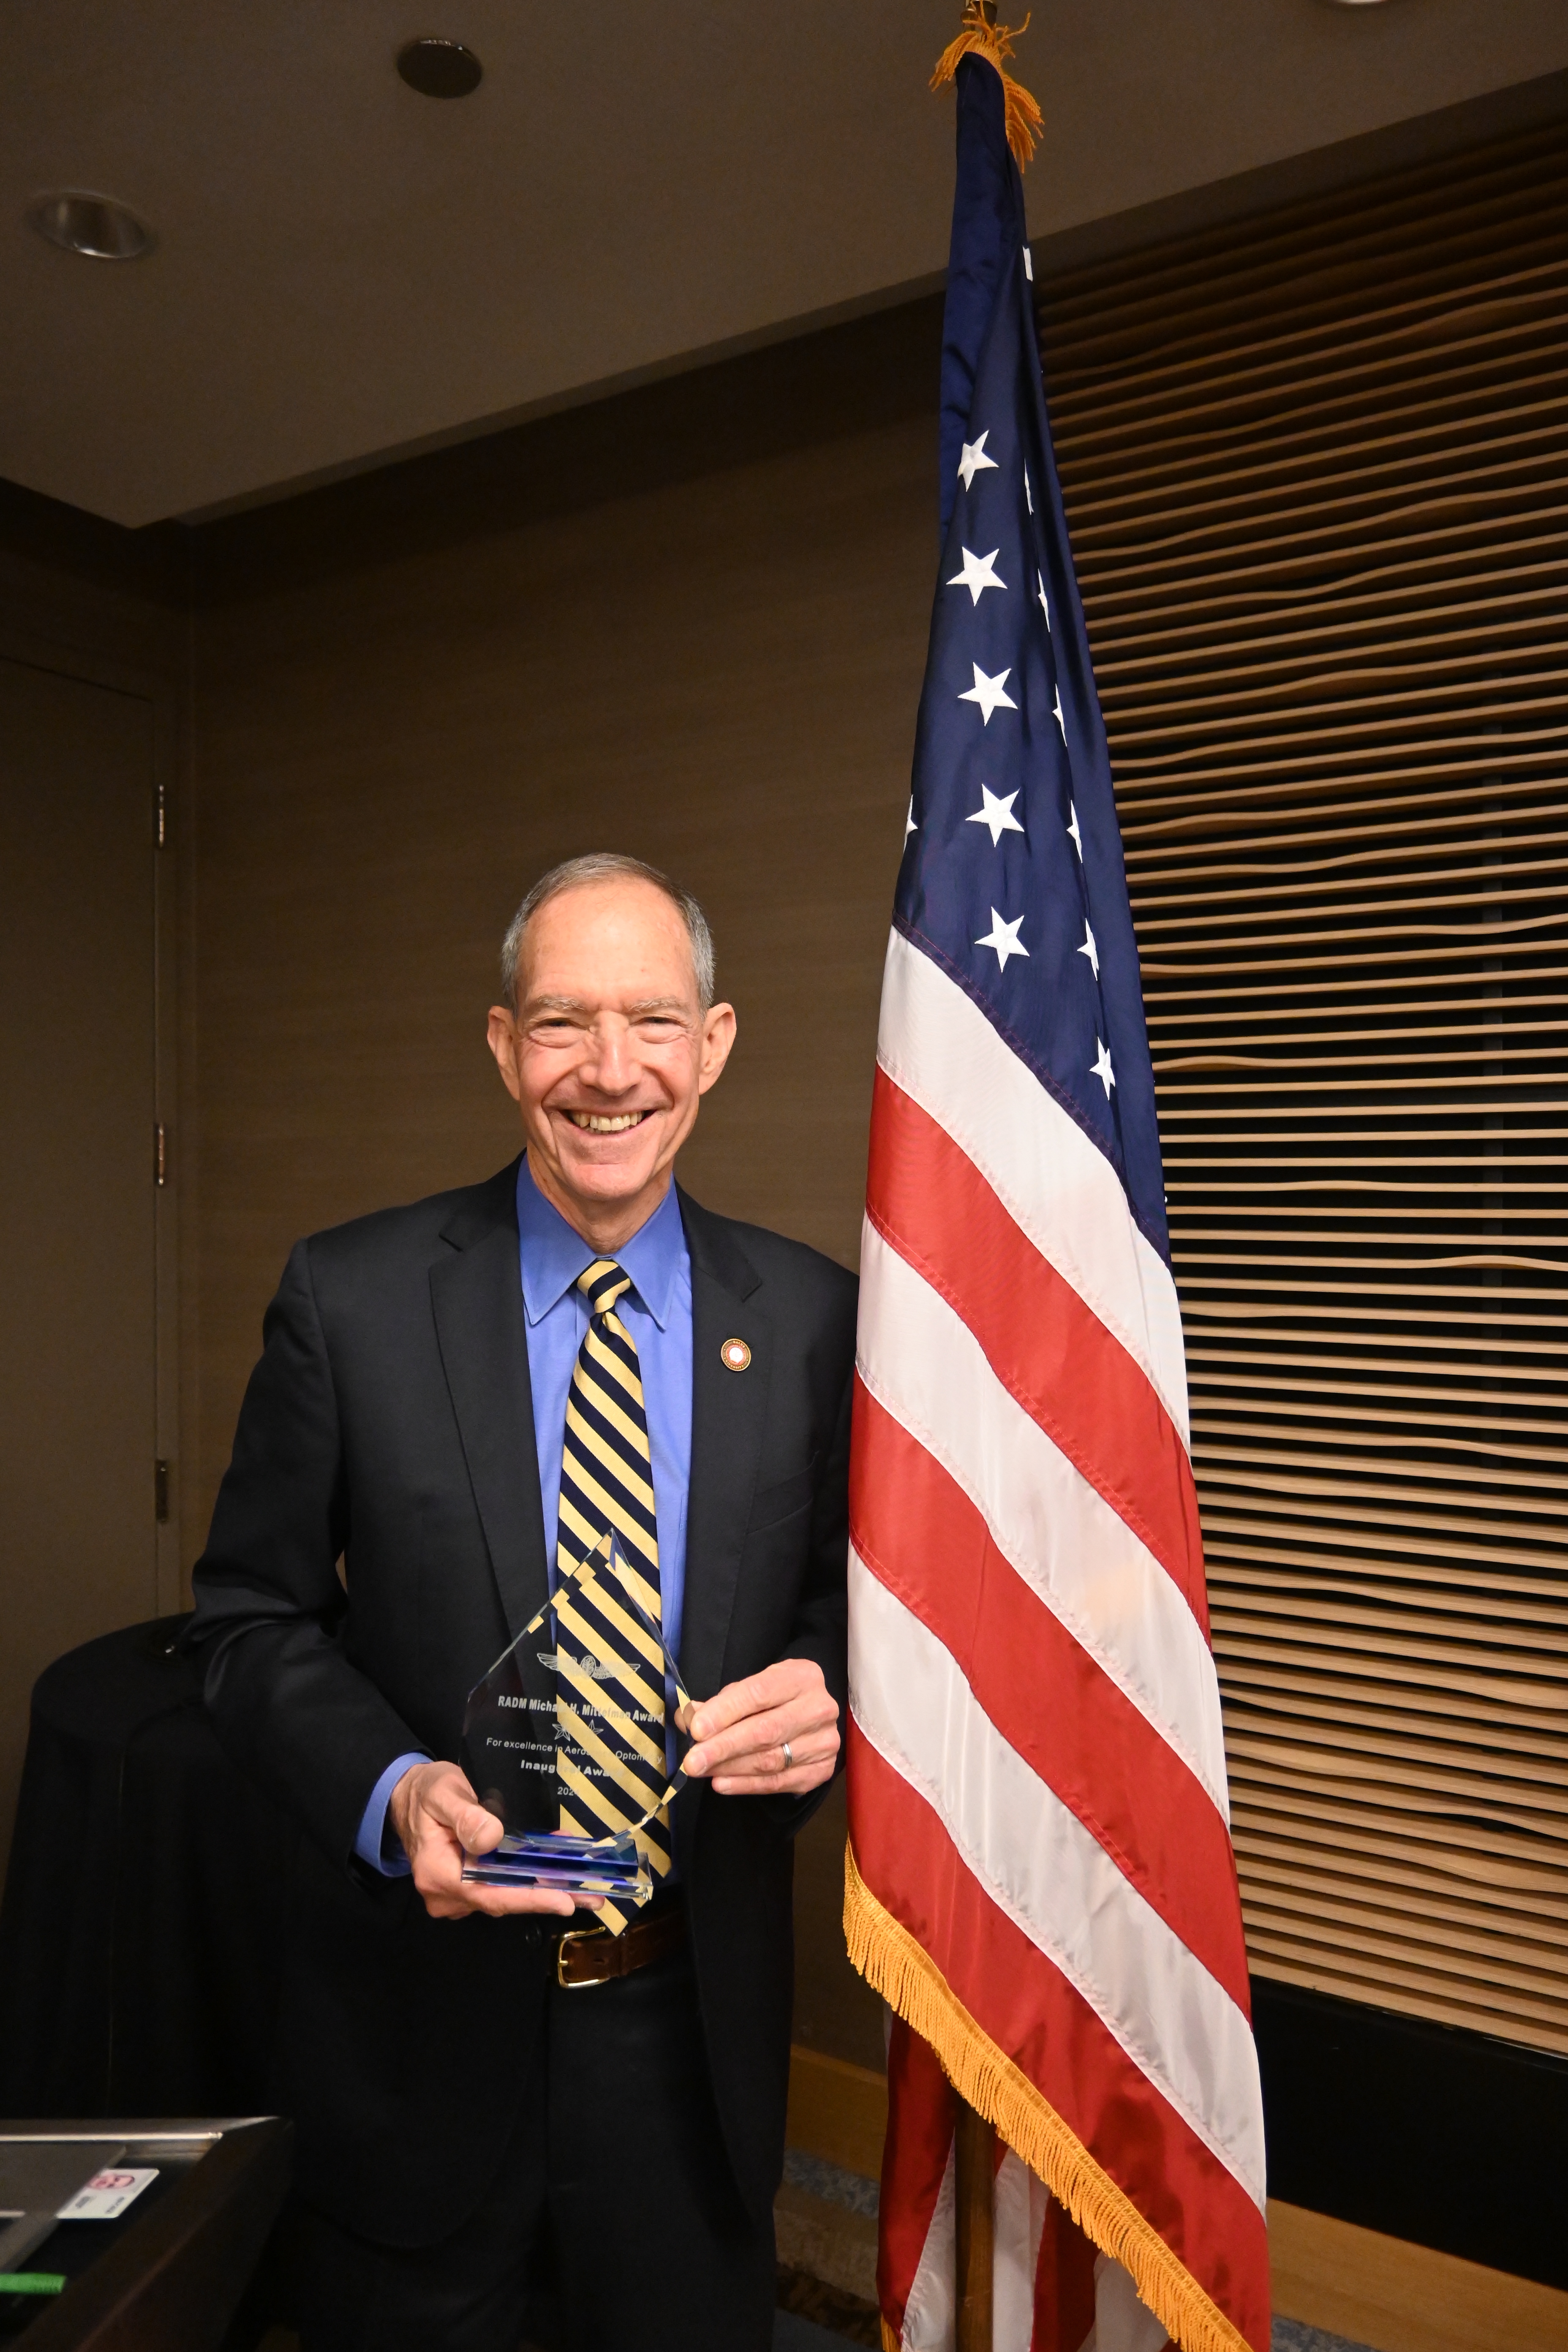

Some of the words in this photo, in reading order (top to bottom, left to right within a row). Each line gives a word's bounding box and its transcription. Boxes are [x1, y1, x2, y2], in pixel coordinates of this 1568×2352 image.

[724, 1357, 744, 1369] UNIVERSITY
[498, 1695, 528, 1709] RADM
[529, 1699, 569, 1712] Michal
[570, 1703, 579, 1715] H.
[632, 1710, 664, 1723] Award
[486, 1737, 502, 1747] For
[504, 1740, 553, 1752] excellence
[555, 1744, 563, 1753] in
